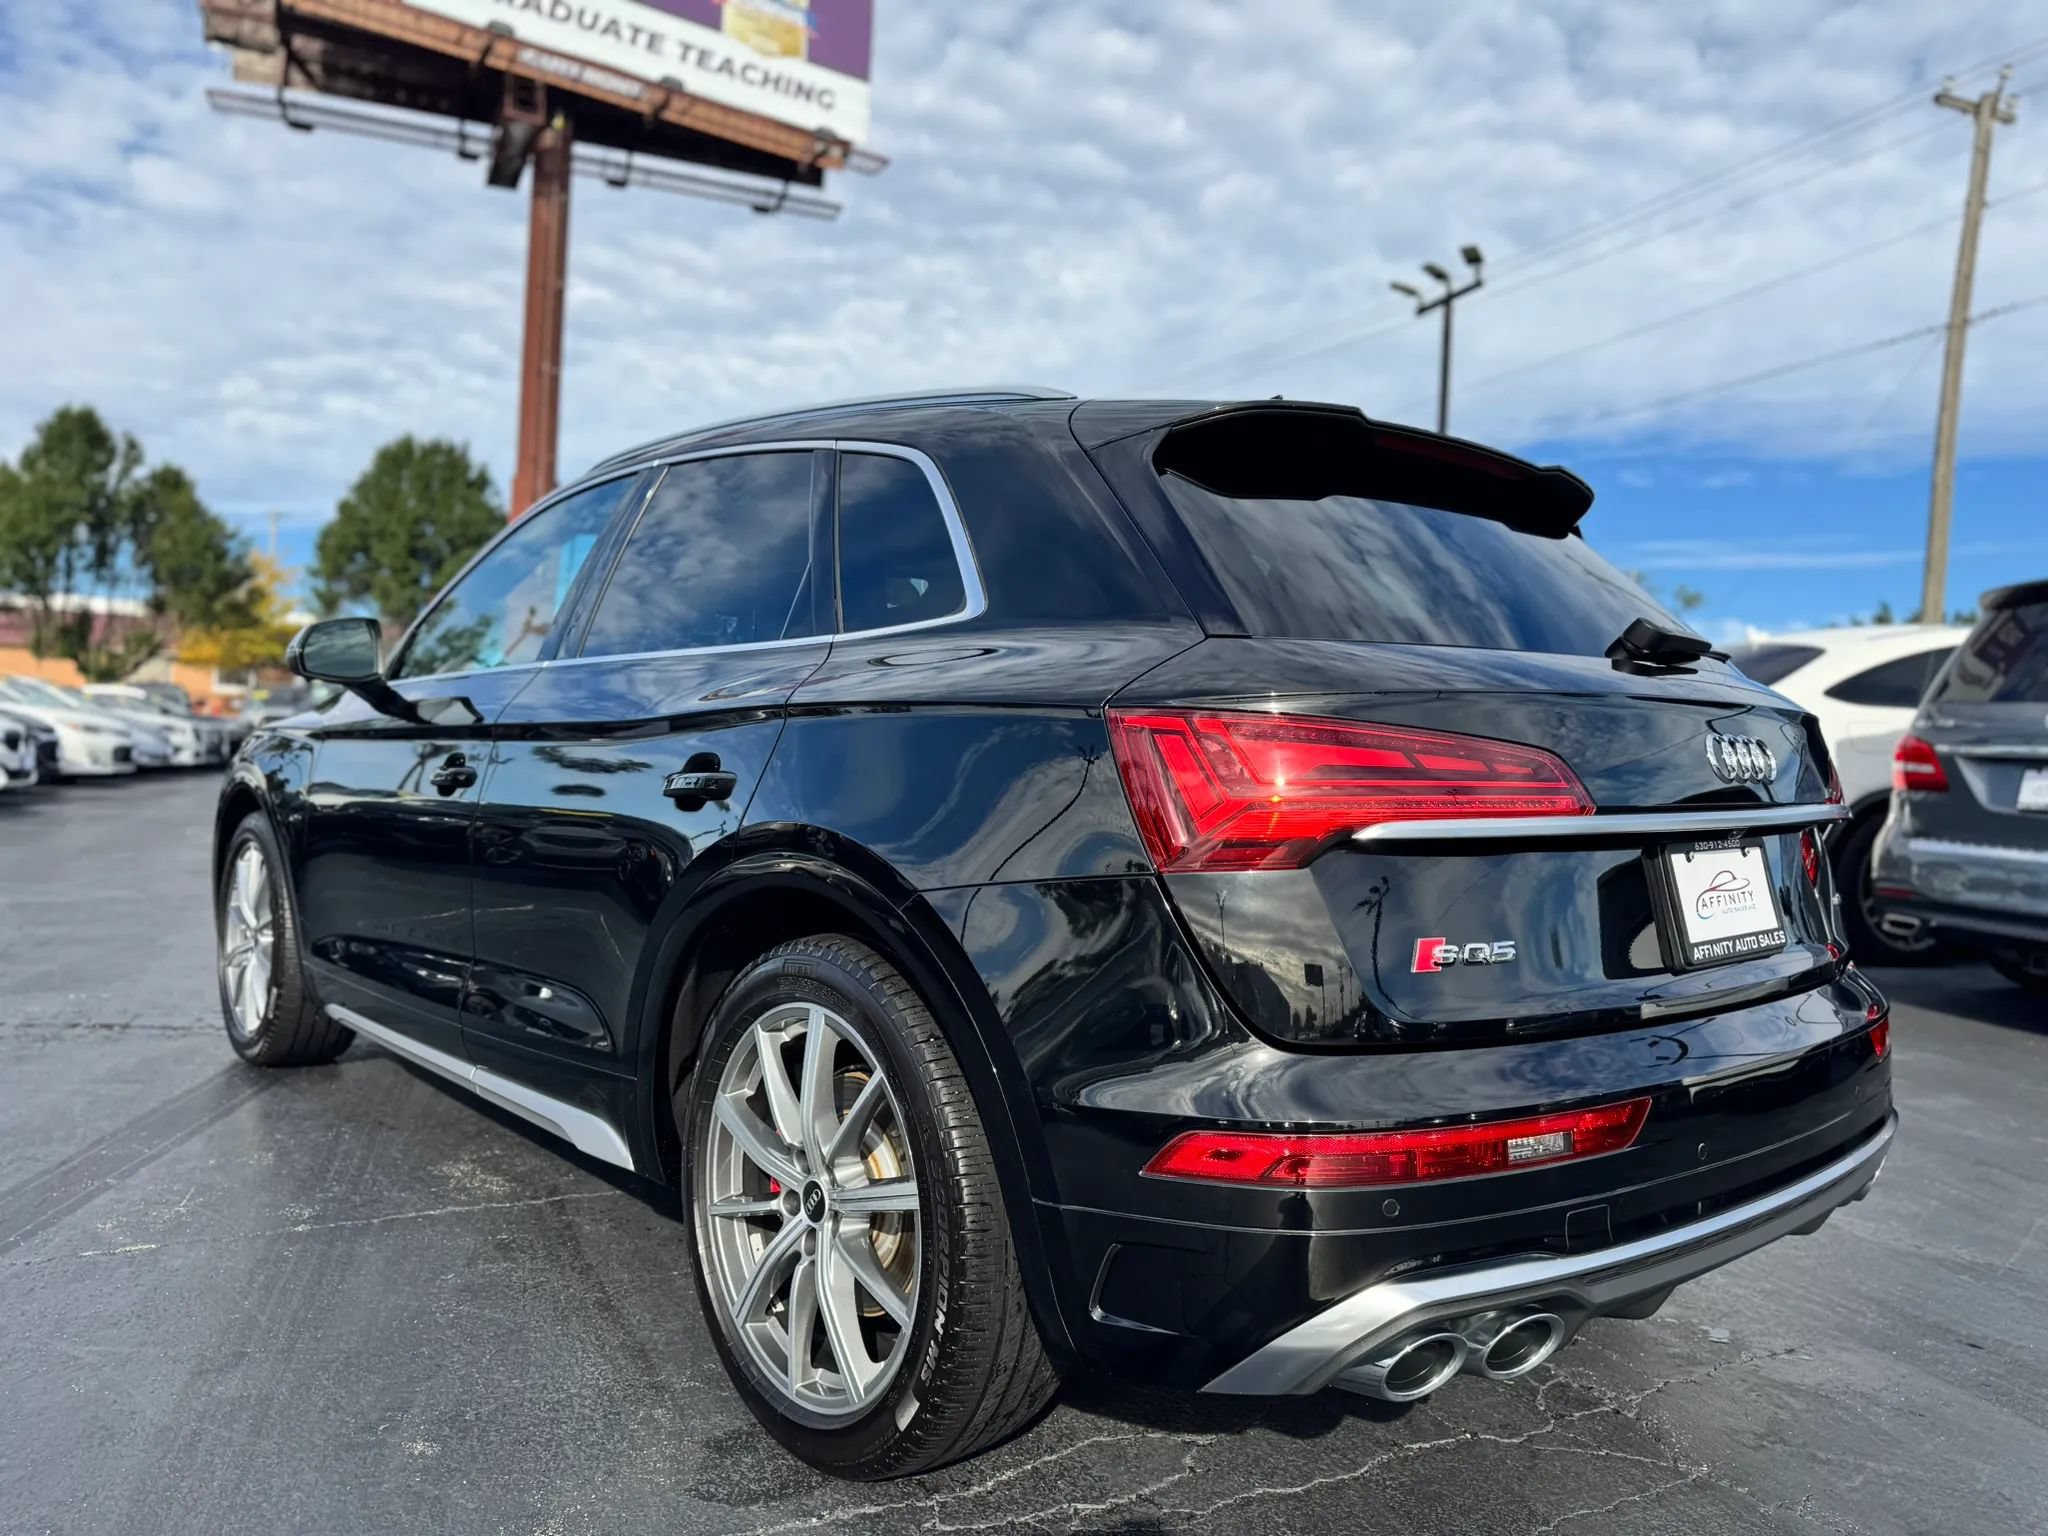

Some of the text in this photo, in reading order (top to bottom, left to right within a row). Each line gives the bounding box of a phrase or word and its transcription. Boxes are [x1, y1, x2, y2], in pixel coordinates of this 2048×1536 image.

[678, 40, 835, 110] TEACHING
[1694, 840, 1741, 851] 630-912-4500
[1701, 889, 1754, 910] AFFINITY
[1431, 940, 1517, 965] SQ5
[1693, 930, 1786, 961] AFFINITY AUTO SALES
